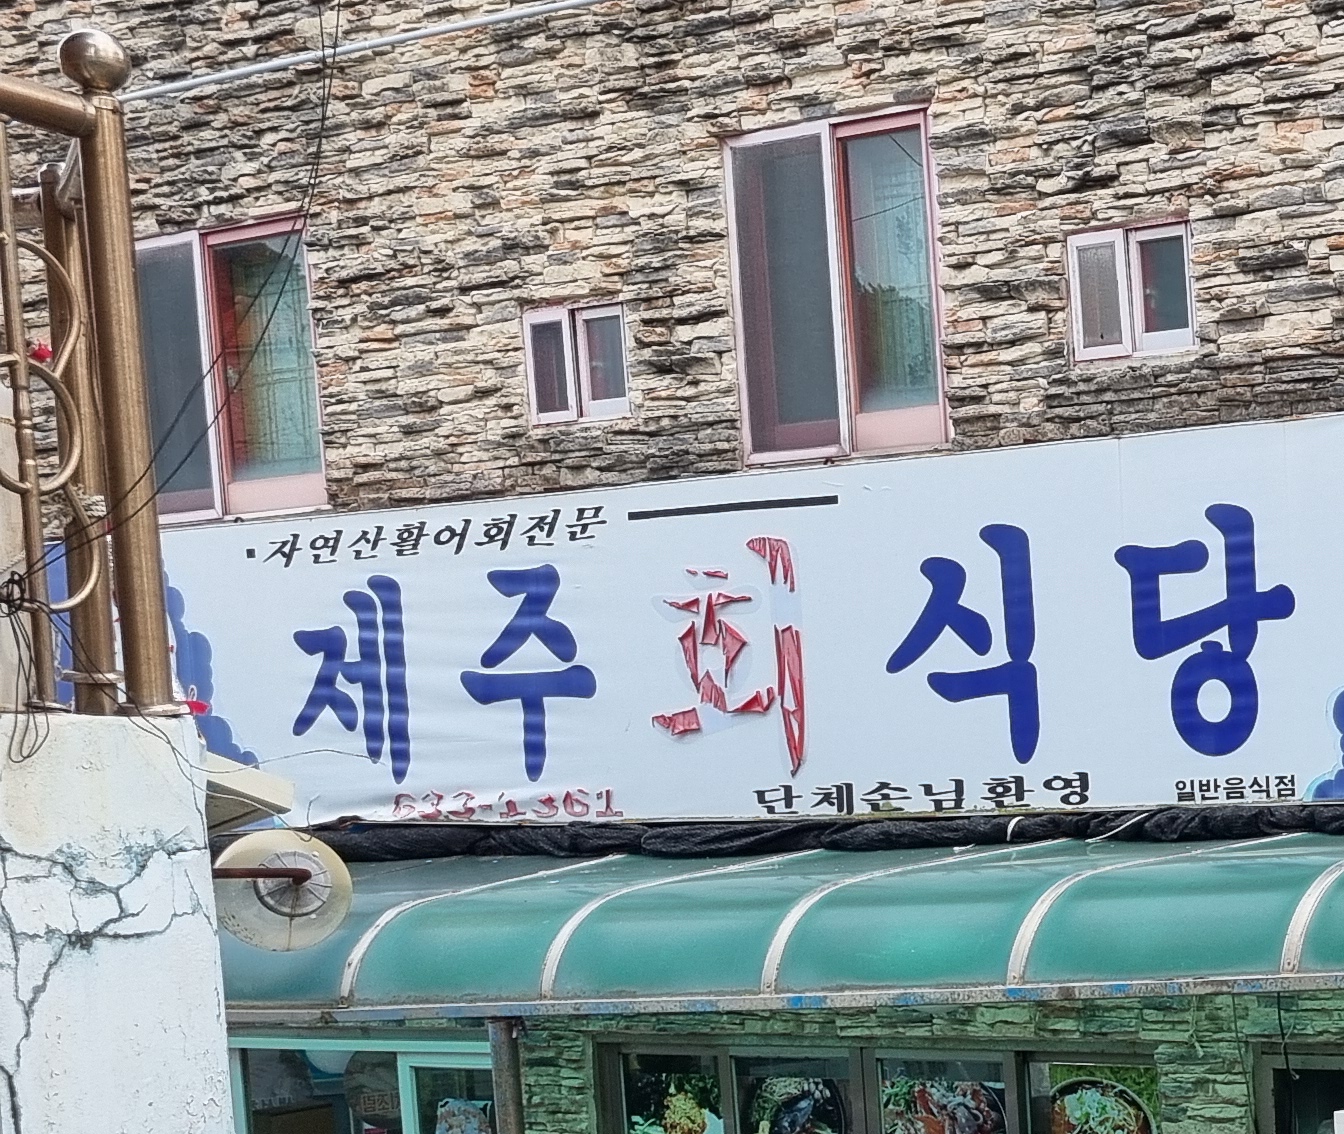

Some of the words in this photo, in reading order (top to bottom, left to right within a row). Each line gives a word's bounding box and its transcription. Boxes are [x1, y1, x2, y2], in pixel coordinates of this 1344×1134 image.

[263, 505, 608, 569] 자연산활어회전문
[753, 771, 1091, 816] 단체손님환영
[1174, 774, 1297, 802] 일반음식점
